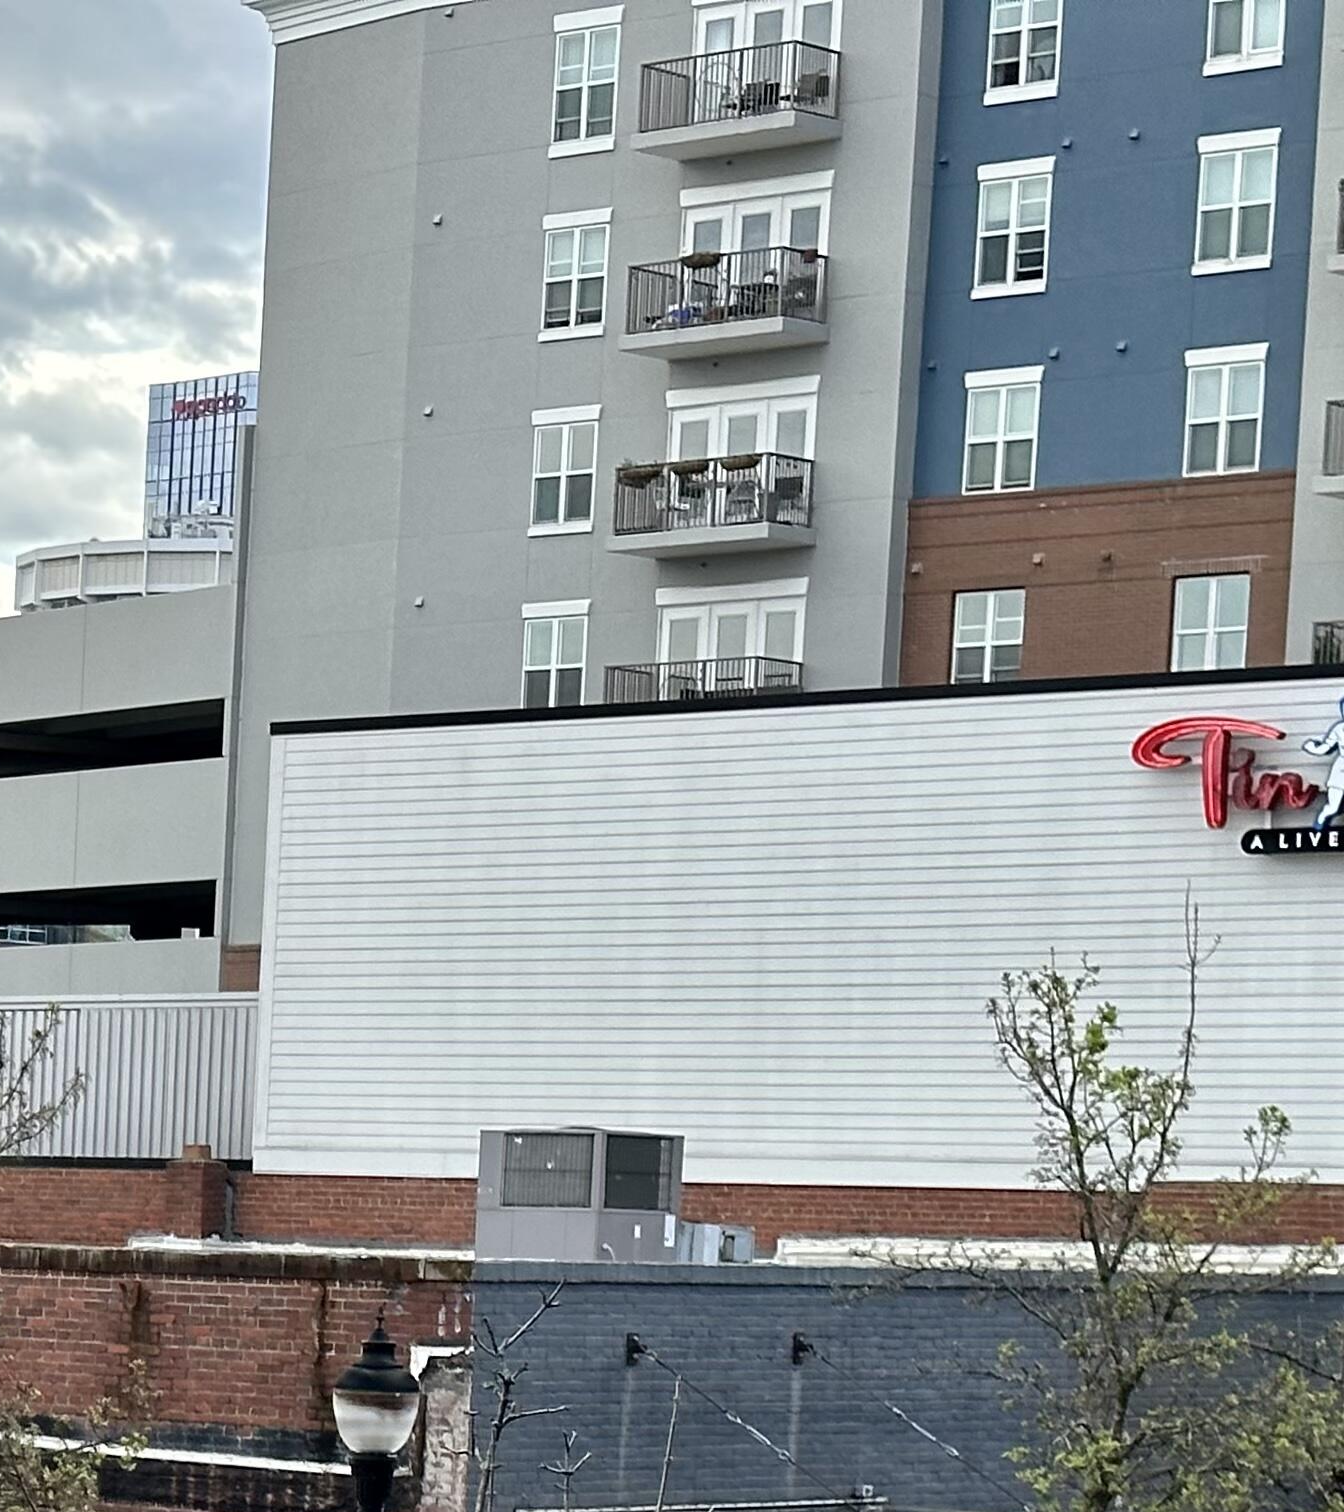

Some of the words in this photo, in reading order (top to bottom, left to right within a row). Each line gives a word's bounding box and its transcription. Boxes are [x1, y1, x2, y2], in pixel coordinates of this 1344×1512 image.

[1131, 716, 1320, 829] Tin
[1250, 834, 1263, 850] A
[1278, 831, 1340, 848] LIVE
